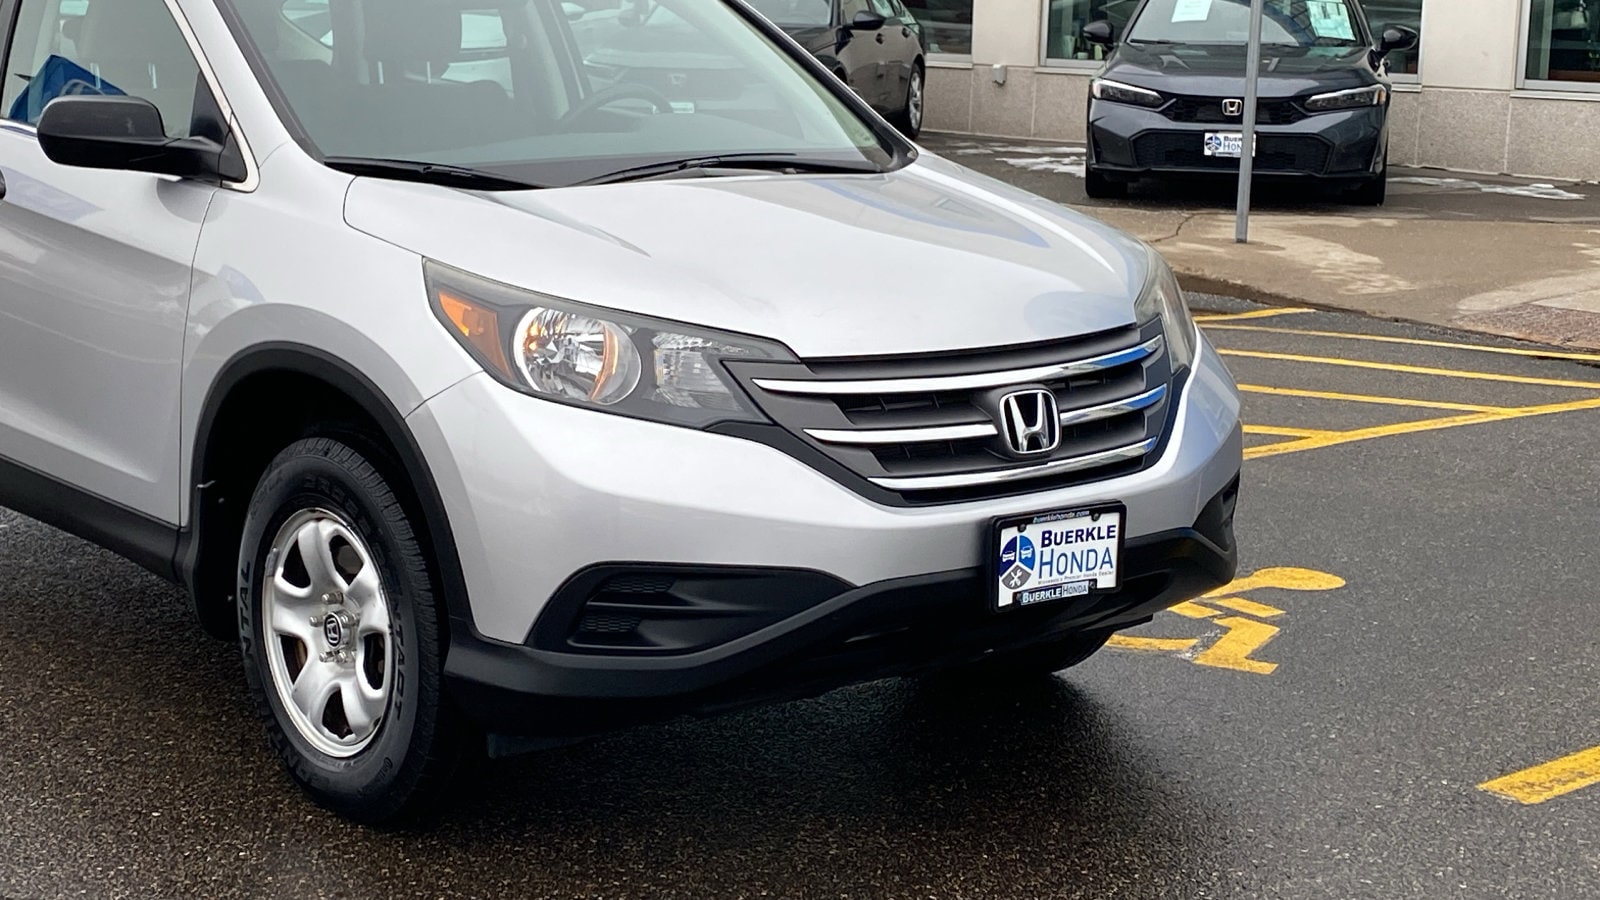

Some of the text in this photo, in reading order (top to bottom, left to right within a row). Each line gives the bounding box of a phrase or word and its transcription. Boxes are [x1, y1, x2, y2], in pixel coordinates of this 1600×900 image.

[1223, 142, 1242, 151] HON
[1040, 525, 1117, 548] BUERKLE
[1038, 547, 1114, 579] HONDA
[1022, 583, 1088, 602] BUERKLE HONDA
